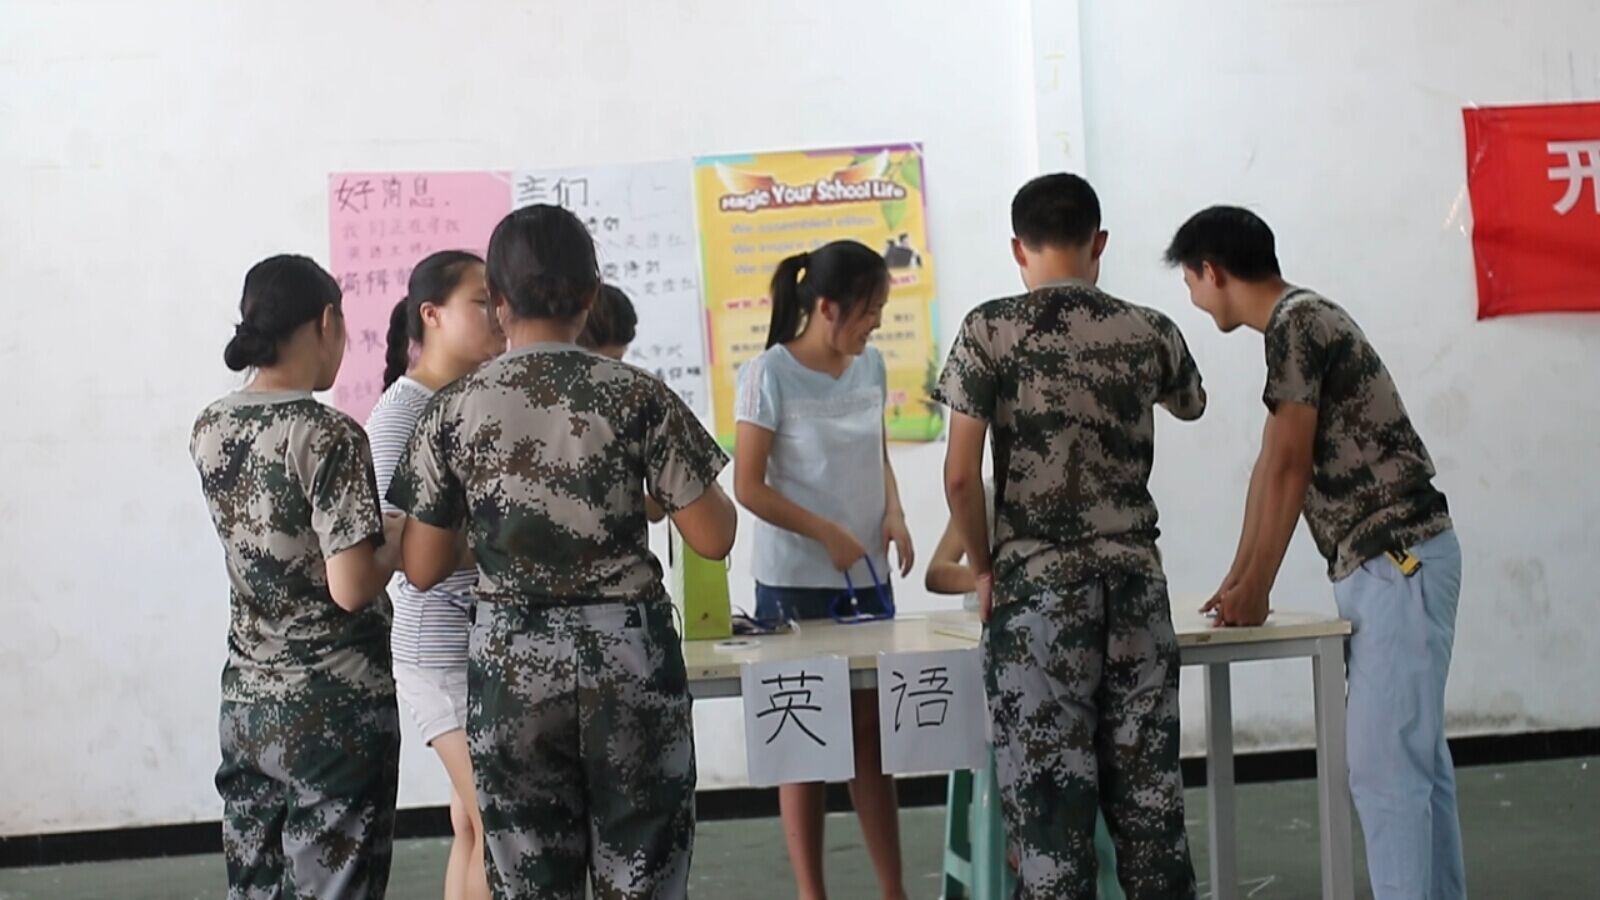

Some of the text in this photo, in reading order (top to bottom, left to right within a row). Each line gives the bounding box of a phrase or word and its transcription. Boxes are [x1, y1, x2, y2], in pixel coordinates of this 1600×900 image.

[772, 185, 813, 204] Your
[816, 179, 871, 200] School
[873, 181, 904, 199] Life
[756, 666, 954, 747] 英 语
